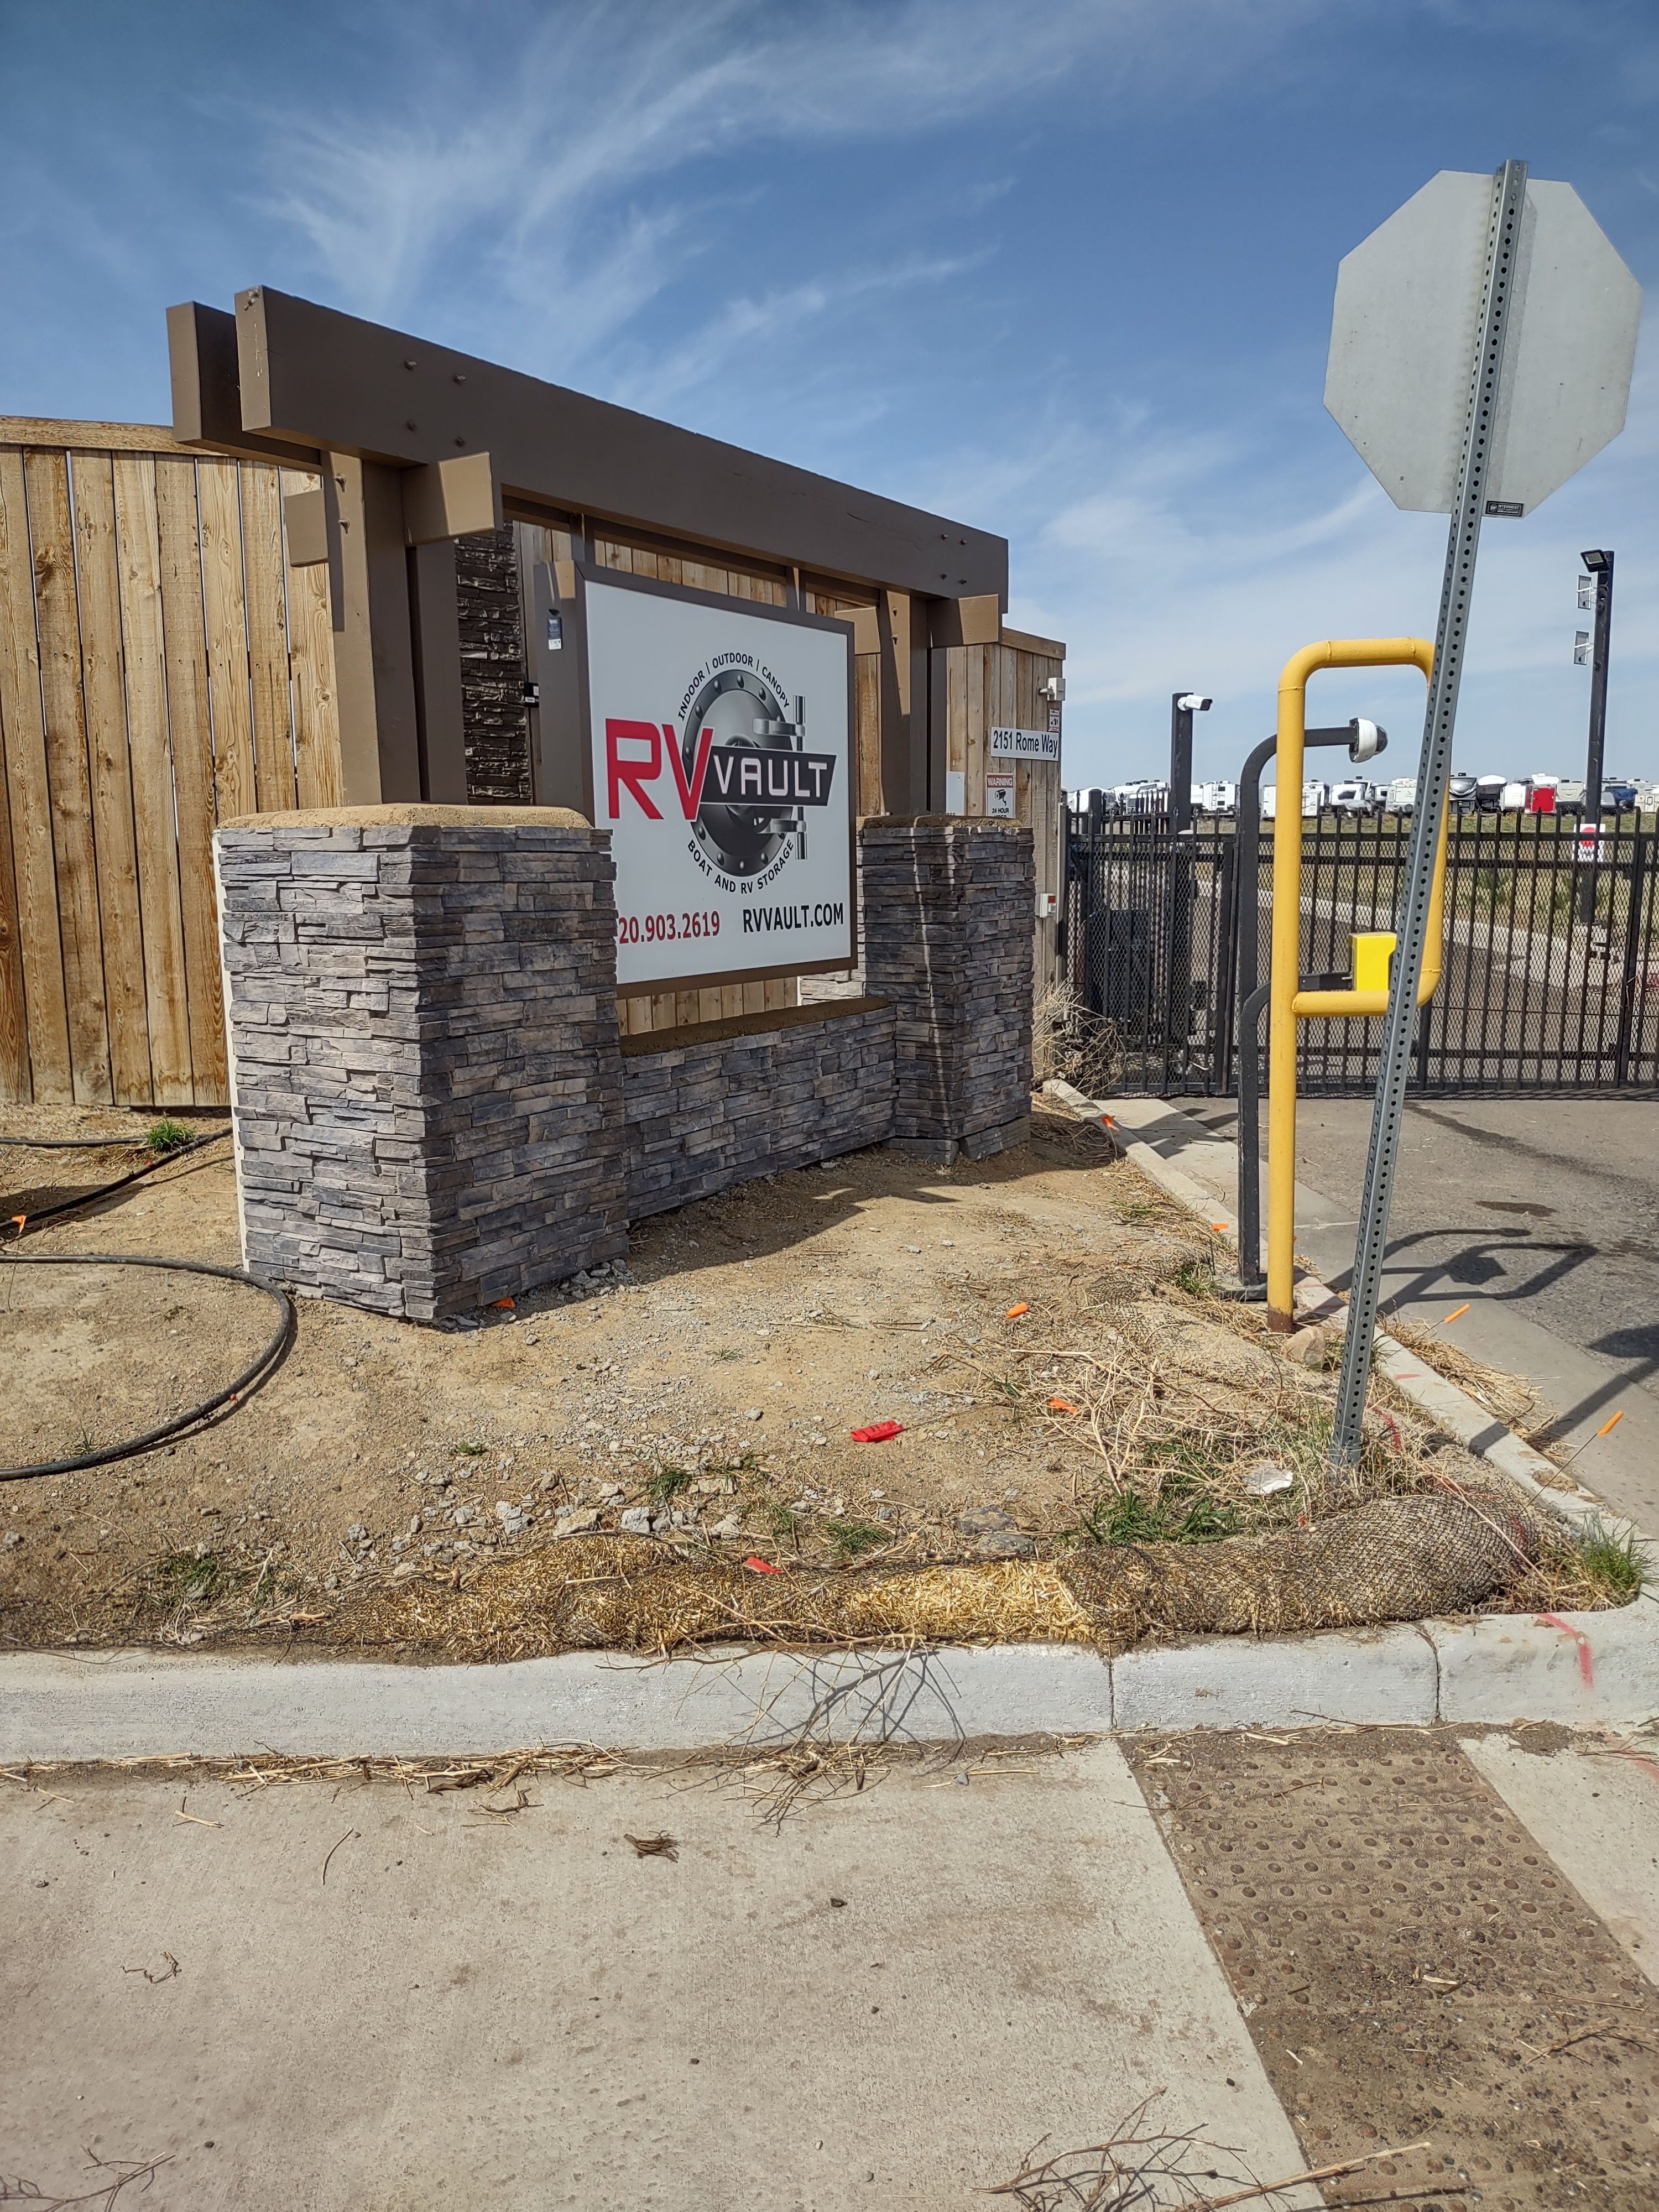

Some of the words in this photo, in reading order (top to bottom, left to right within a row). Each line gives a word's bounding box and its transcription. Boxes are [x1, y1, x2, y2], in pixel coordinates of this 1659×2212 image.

[678, 670, 706, 721] INDOOR
[712, 652, 753, 669] OUTDOOR
[762, 666, 790, 708] CANOPY
[993, 730, 1013, 750] 2151
[1016, 732, 1039, 752] Rome
[1041, 734, 1058, 758] Way
[606, 718, 714, 821] RV
[713, 754, 828, 797] VAULT
[987, 778, 1013, 786] WARNING
[687, 839, 713, 877] BOAT
[714, 874, 736, 893] AND
[740, 881, 753, 894] RV
[757, 839, 794, 890] STORAGE
[743, 902, 844, 933] RVVAULT.COM
